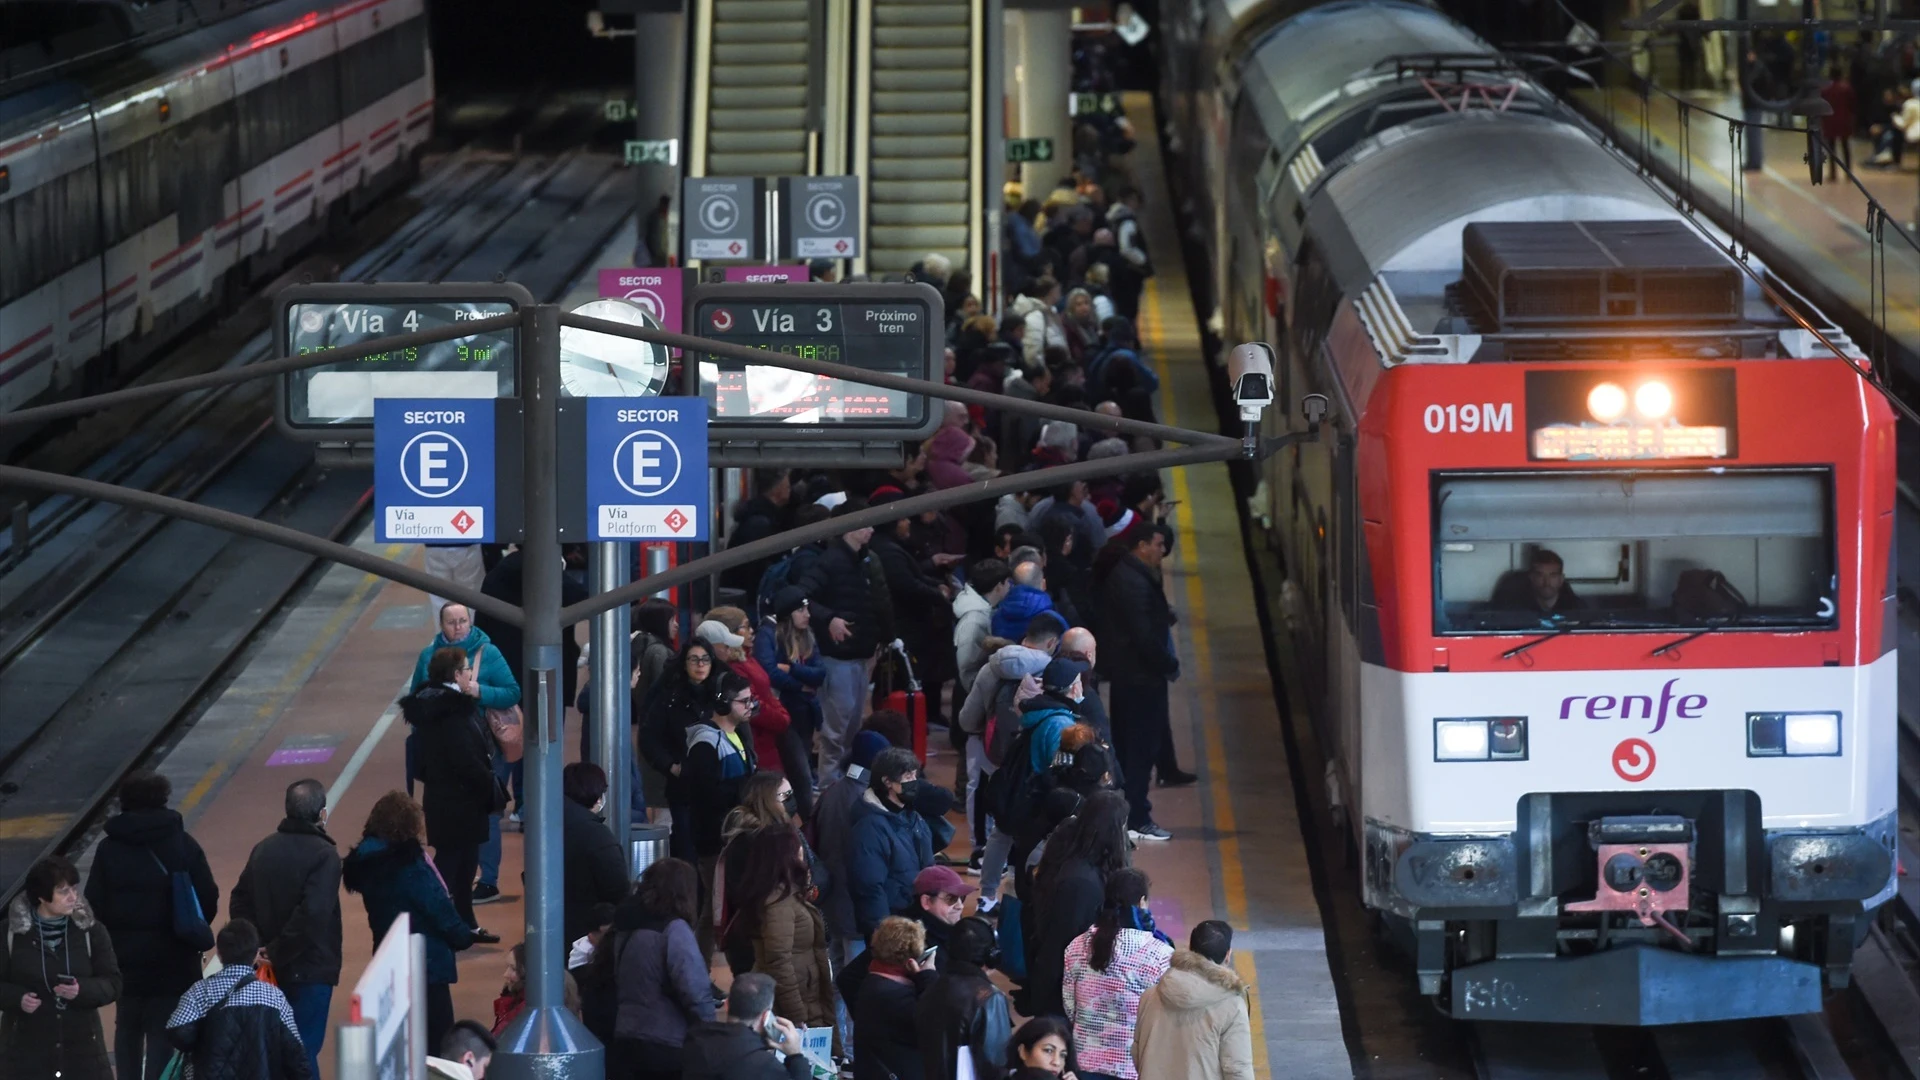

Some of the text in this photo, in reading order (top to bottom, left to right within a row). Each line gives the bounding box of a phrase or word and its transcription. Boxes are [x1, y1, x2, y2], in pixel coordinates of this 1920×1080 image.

[707, 199, 731, 228] C
[813, 199, 837, 227] C
[619, 276, 662, 286] SECTOR
[342, 309, 419, 333] Vía 4
[752, 308, 833, 333] Vía 3
[865, 309, 917, 323] Próximo
[879, 323, 905, 334] tren
[457, 345, 469, 361] 9
[404, 411, 466, 424] SECTOR
[617, 409, 679, 423] SECTOR
[1424, 402, 1514, 434] 019M
[419, 442, 449, 487] E
[633, 441, 662, 486] E
[395, 508, 469, 529] Vía 4
[608, 507, 682, 528] Vía 3
[395, 523, 444, 537] Platform
[608, 522, 657, 536] Platform
[1559, 677, 1708, 734] renfe
